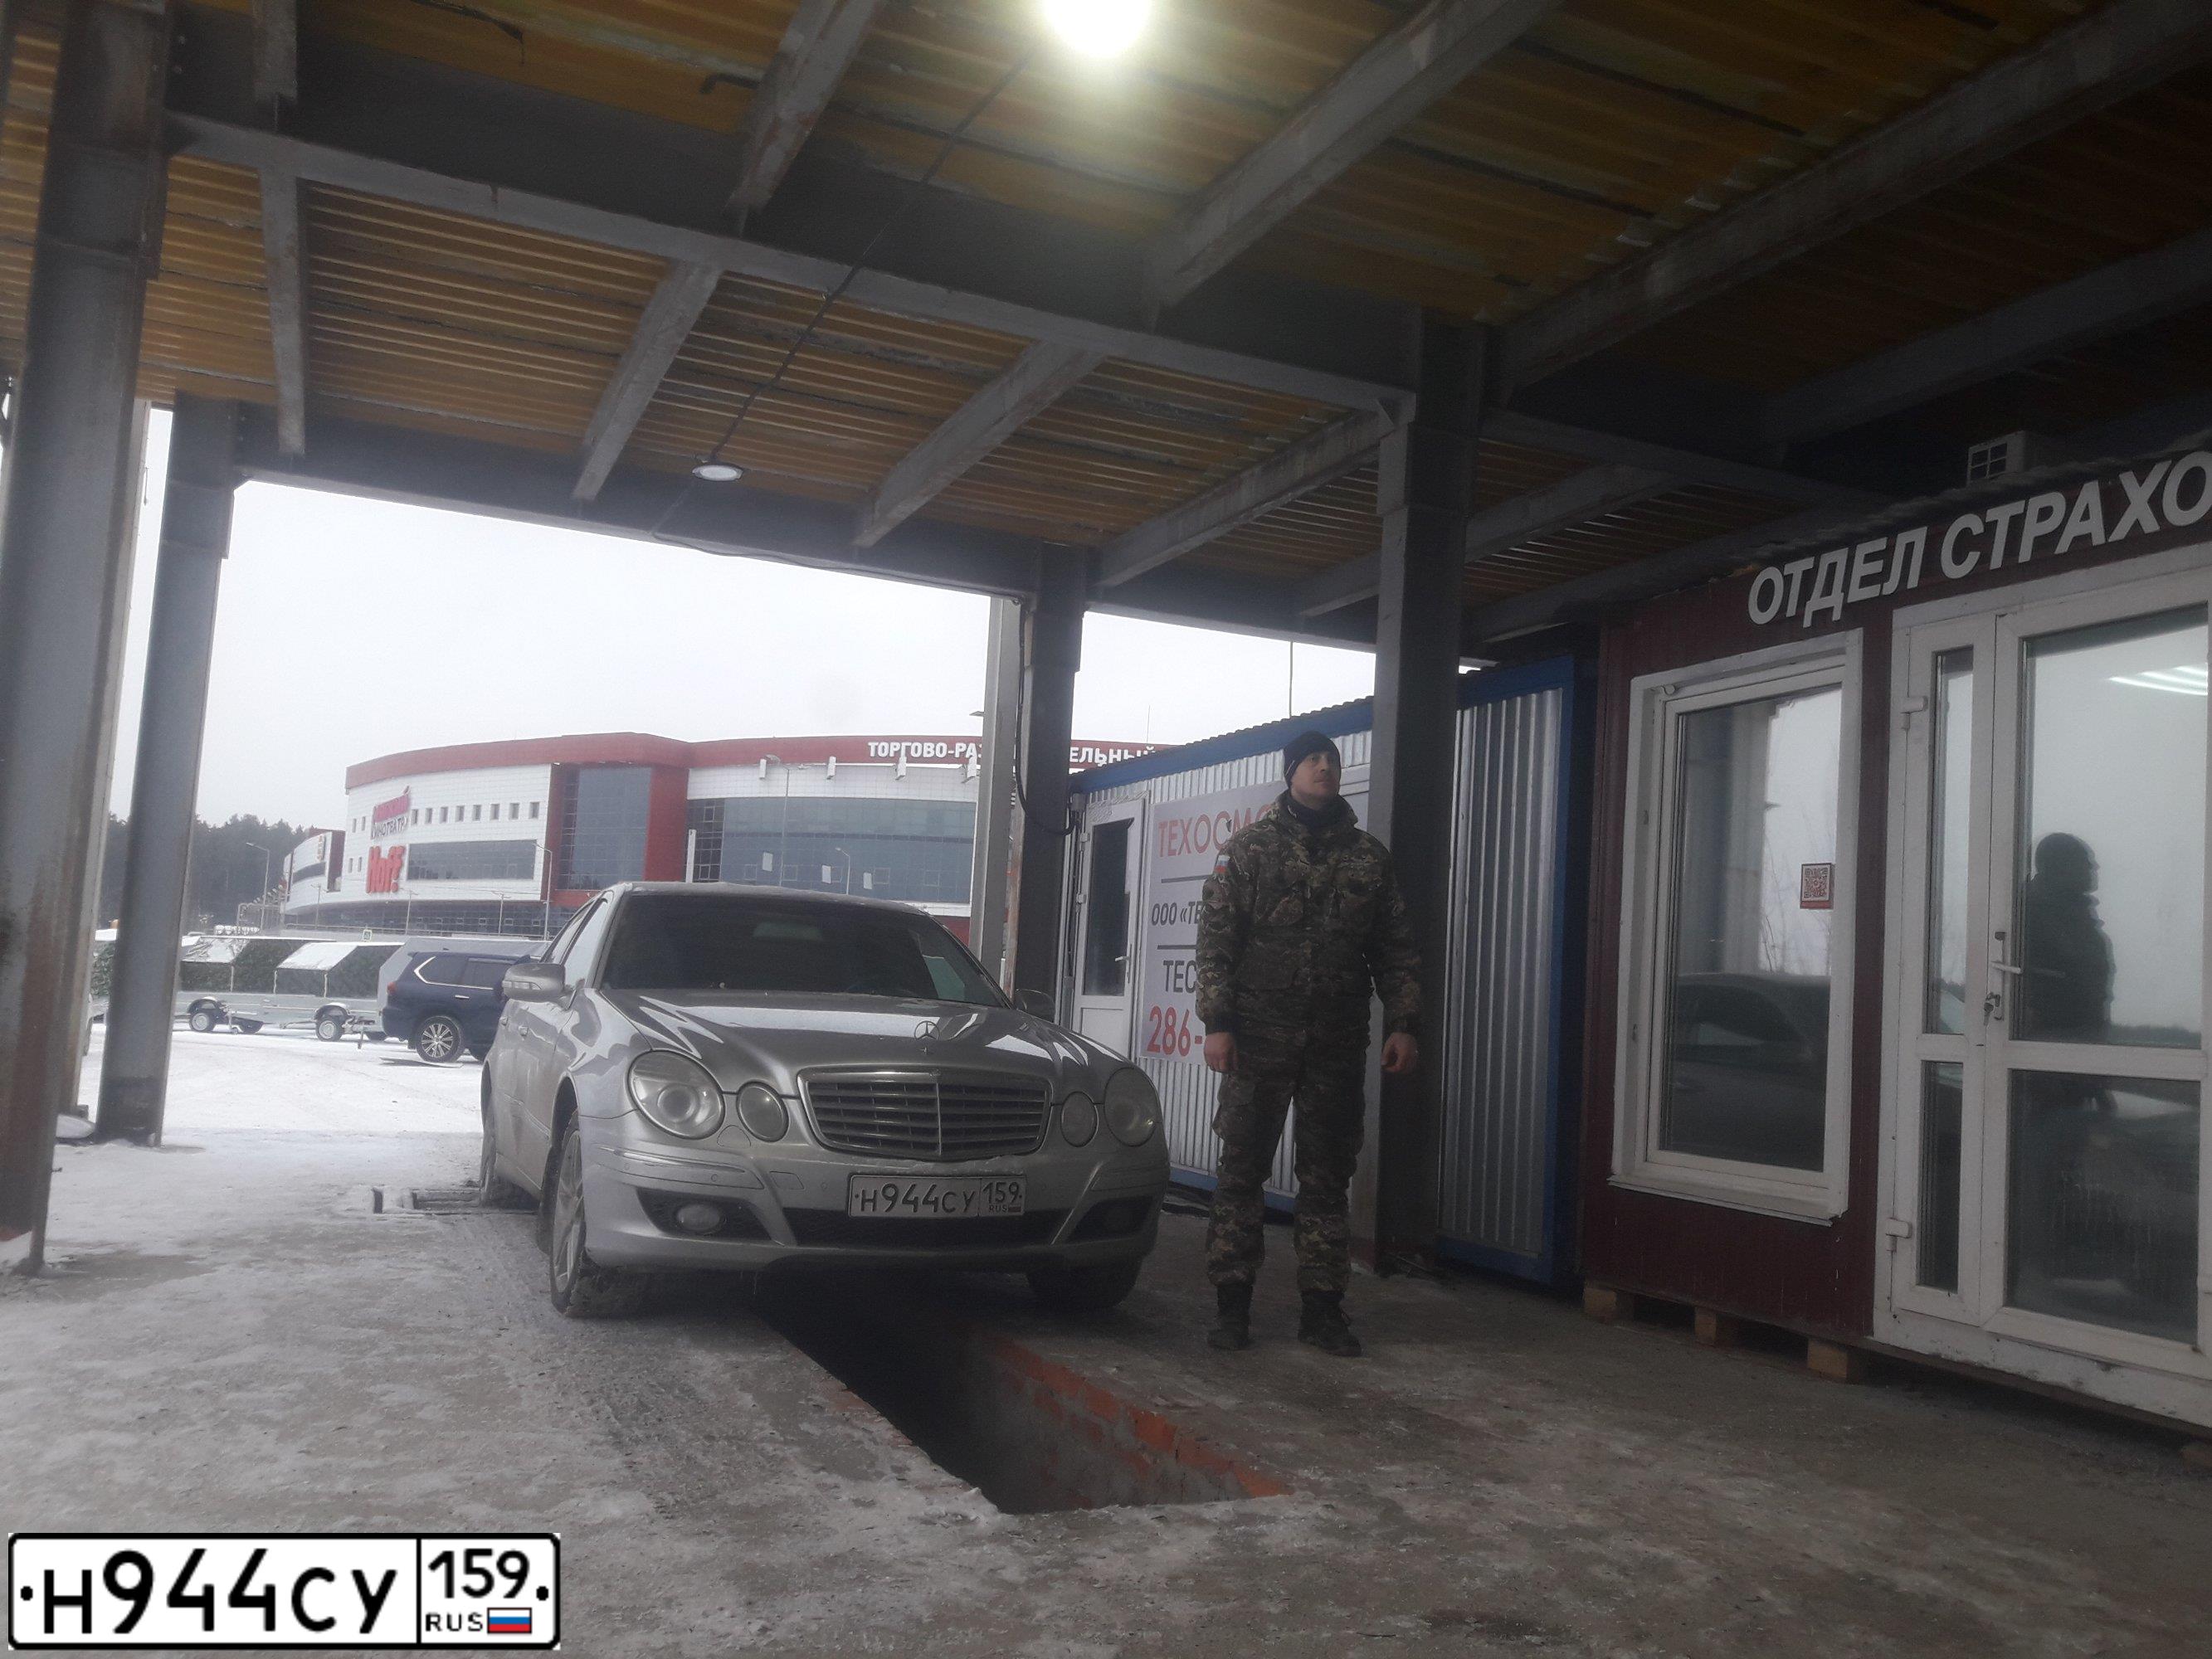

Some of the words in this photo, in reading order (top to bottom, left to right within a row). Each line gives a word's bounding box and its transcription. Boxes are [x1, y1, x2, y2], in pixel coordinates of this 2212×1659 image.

[1748, 526, 1928, 628] ОТДЕЛ
[1941, 450, 2212, 579] СТРАХО
[868, 742, 982, 758] ТОРГОВО-РА
[1152, 902, 1177, 926] ООО
[1163, 960, 1197, 993] ТЕС
[1147, 1005, 1203, 1057] 286-
[860, 1183, 976, 1213] Н944СУ
[983, 1181, 1020, 1204] 159
